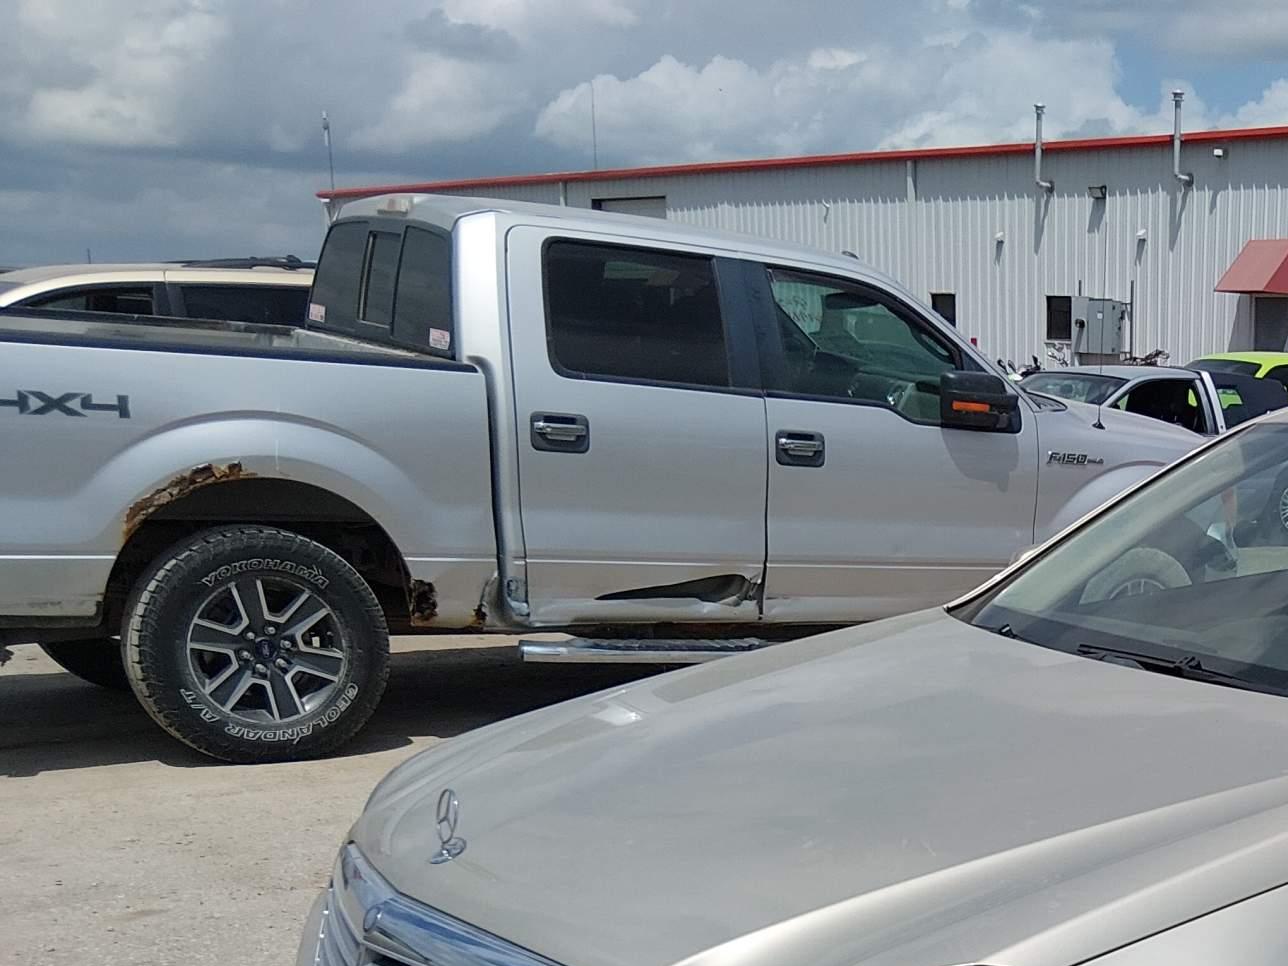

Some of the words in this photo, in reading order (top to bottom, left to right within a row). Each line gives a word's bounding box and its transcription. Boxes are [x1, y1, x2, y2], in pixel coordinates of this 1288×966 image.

[201, 558, 330, 589] YOKOHAMA
[180, 688, 220, 723] A/T
[225, 682, 359, 744] GEOLANDAR
